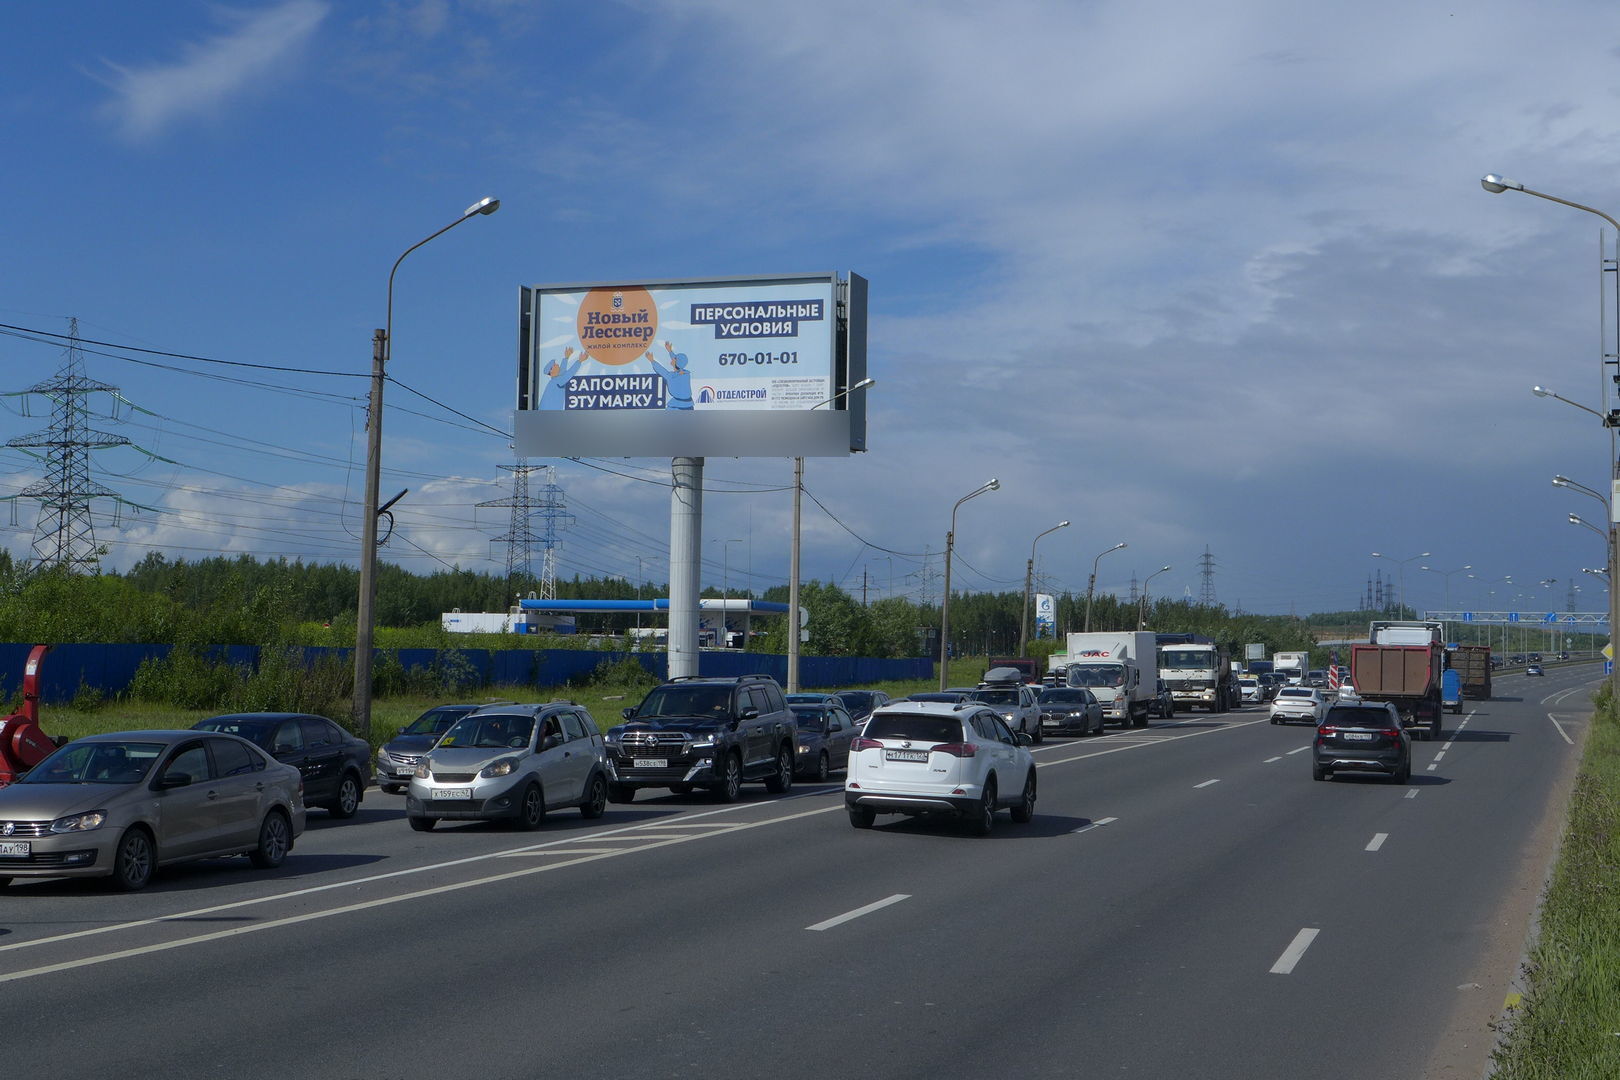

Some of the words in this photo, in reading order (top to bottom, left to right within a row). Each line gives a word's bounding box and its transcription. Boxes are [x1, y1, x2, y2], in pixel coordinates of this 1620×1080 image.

[587, 309, 649, 325] Новый
[695, 304, 819, 321] ПЕРСОНАЛЬНЫЕ
[581, 326, 654, 342] Лесснер
[720, 321, 793, 336] УСЛОВИЯ
[718, 351, 798, 366] 670-01-01
[568, 377, 653, 392] ЗАПОМНИ
[716, 387, 767, 400] ОТДЕЛСТРОЙ
[568, 394, 597, 409] ЭТУ
